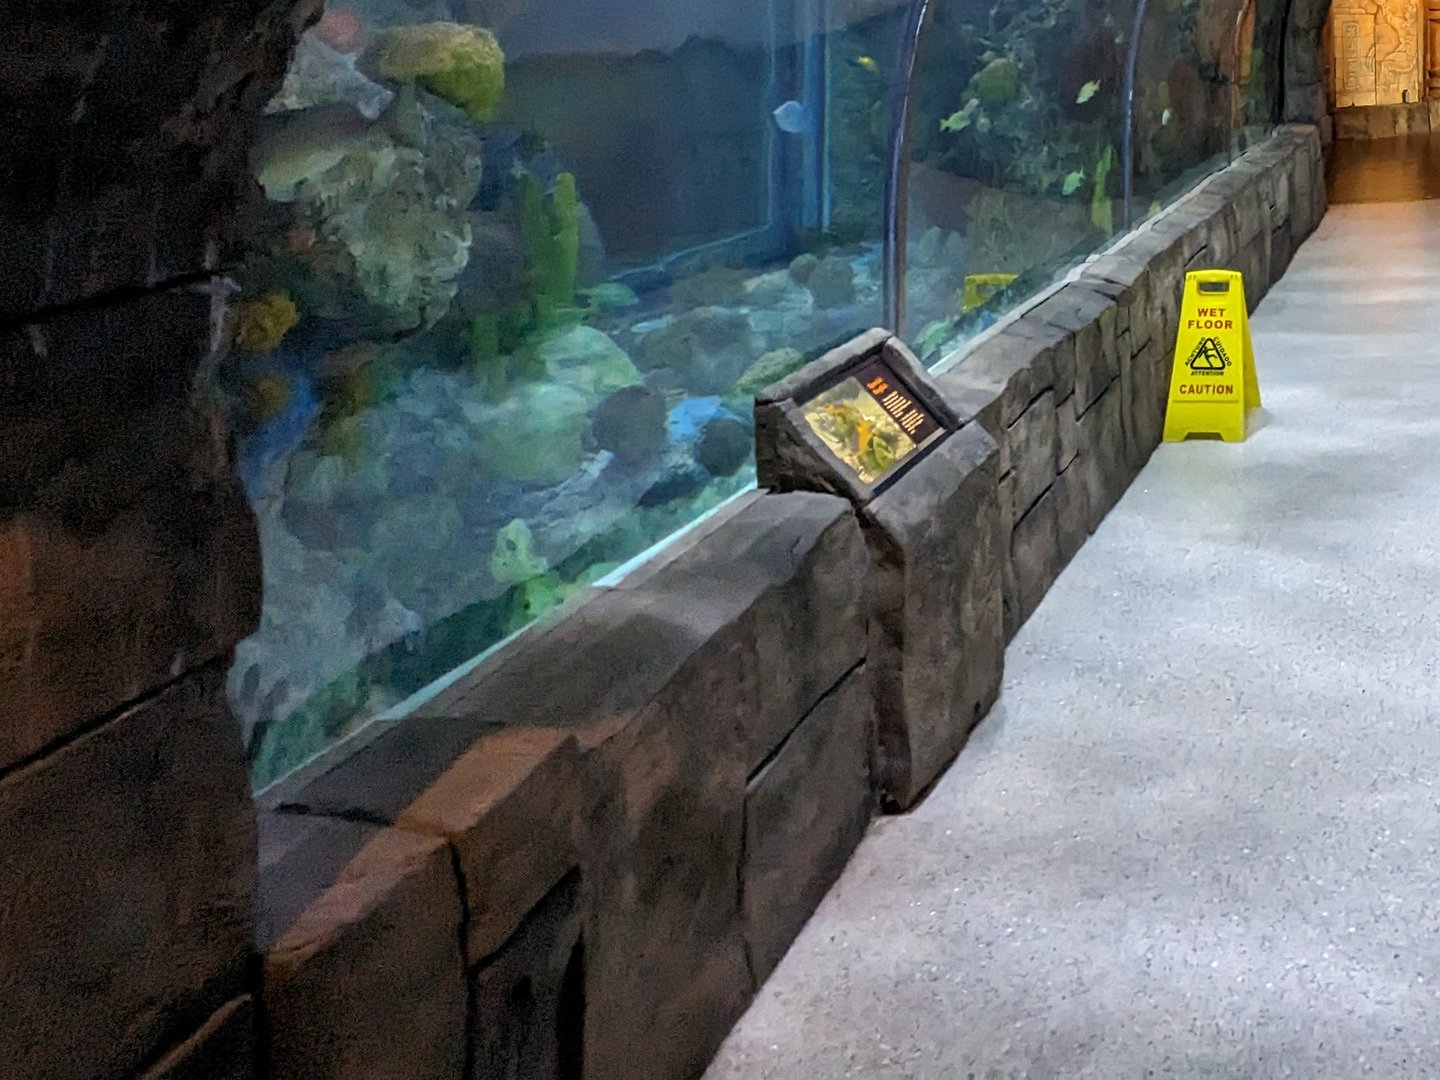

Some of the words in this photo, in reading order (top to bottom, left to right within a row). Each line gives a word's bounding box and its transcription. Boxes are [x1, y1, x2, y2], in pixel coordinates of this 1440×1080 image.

[1197, 308, 1226, 317] WET
[1187, 320, 1233, 329] FLOOR
[1185, 337, 1206, 366] ACHTUNG
[1213, 337, 1232, 366] CUIDADO
[1179, 384, 1234, 395] CAUTION
